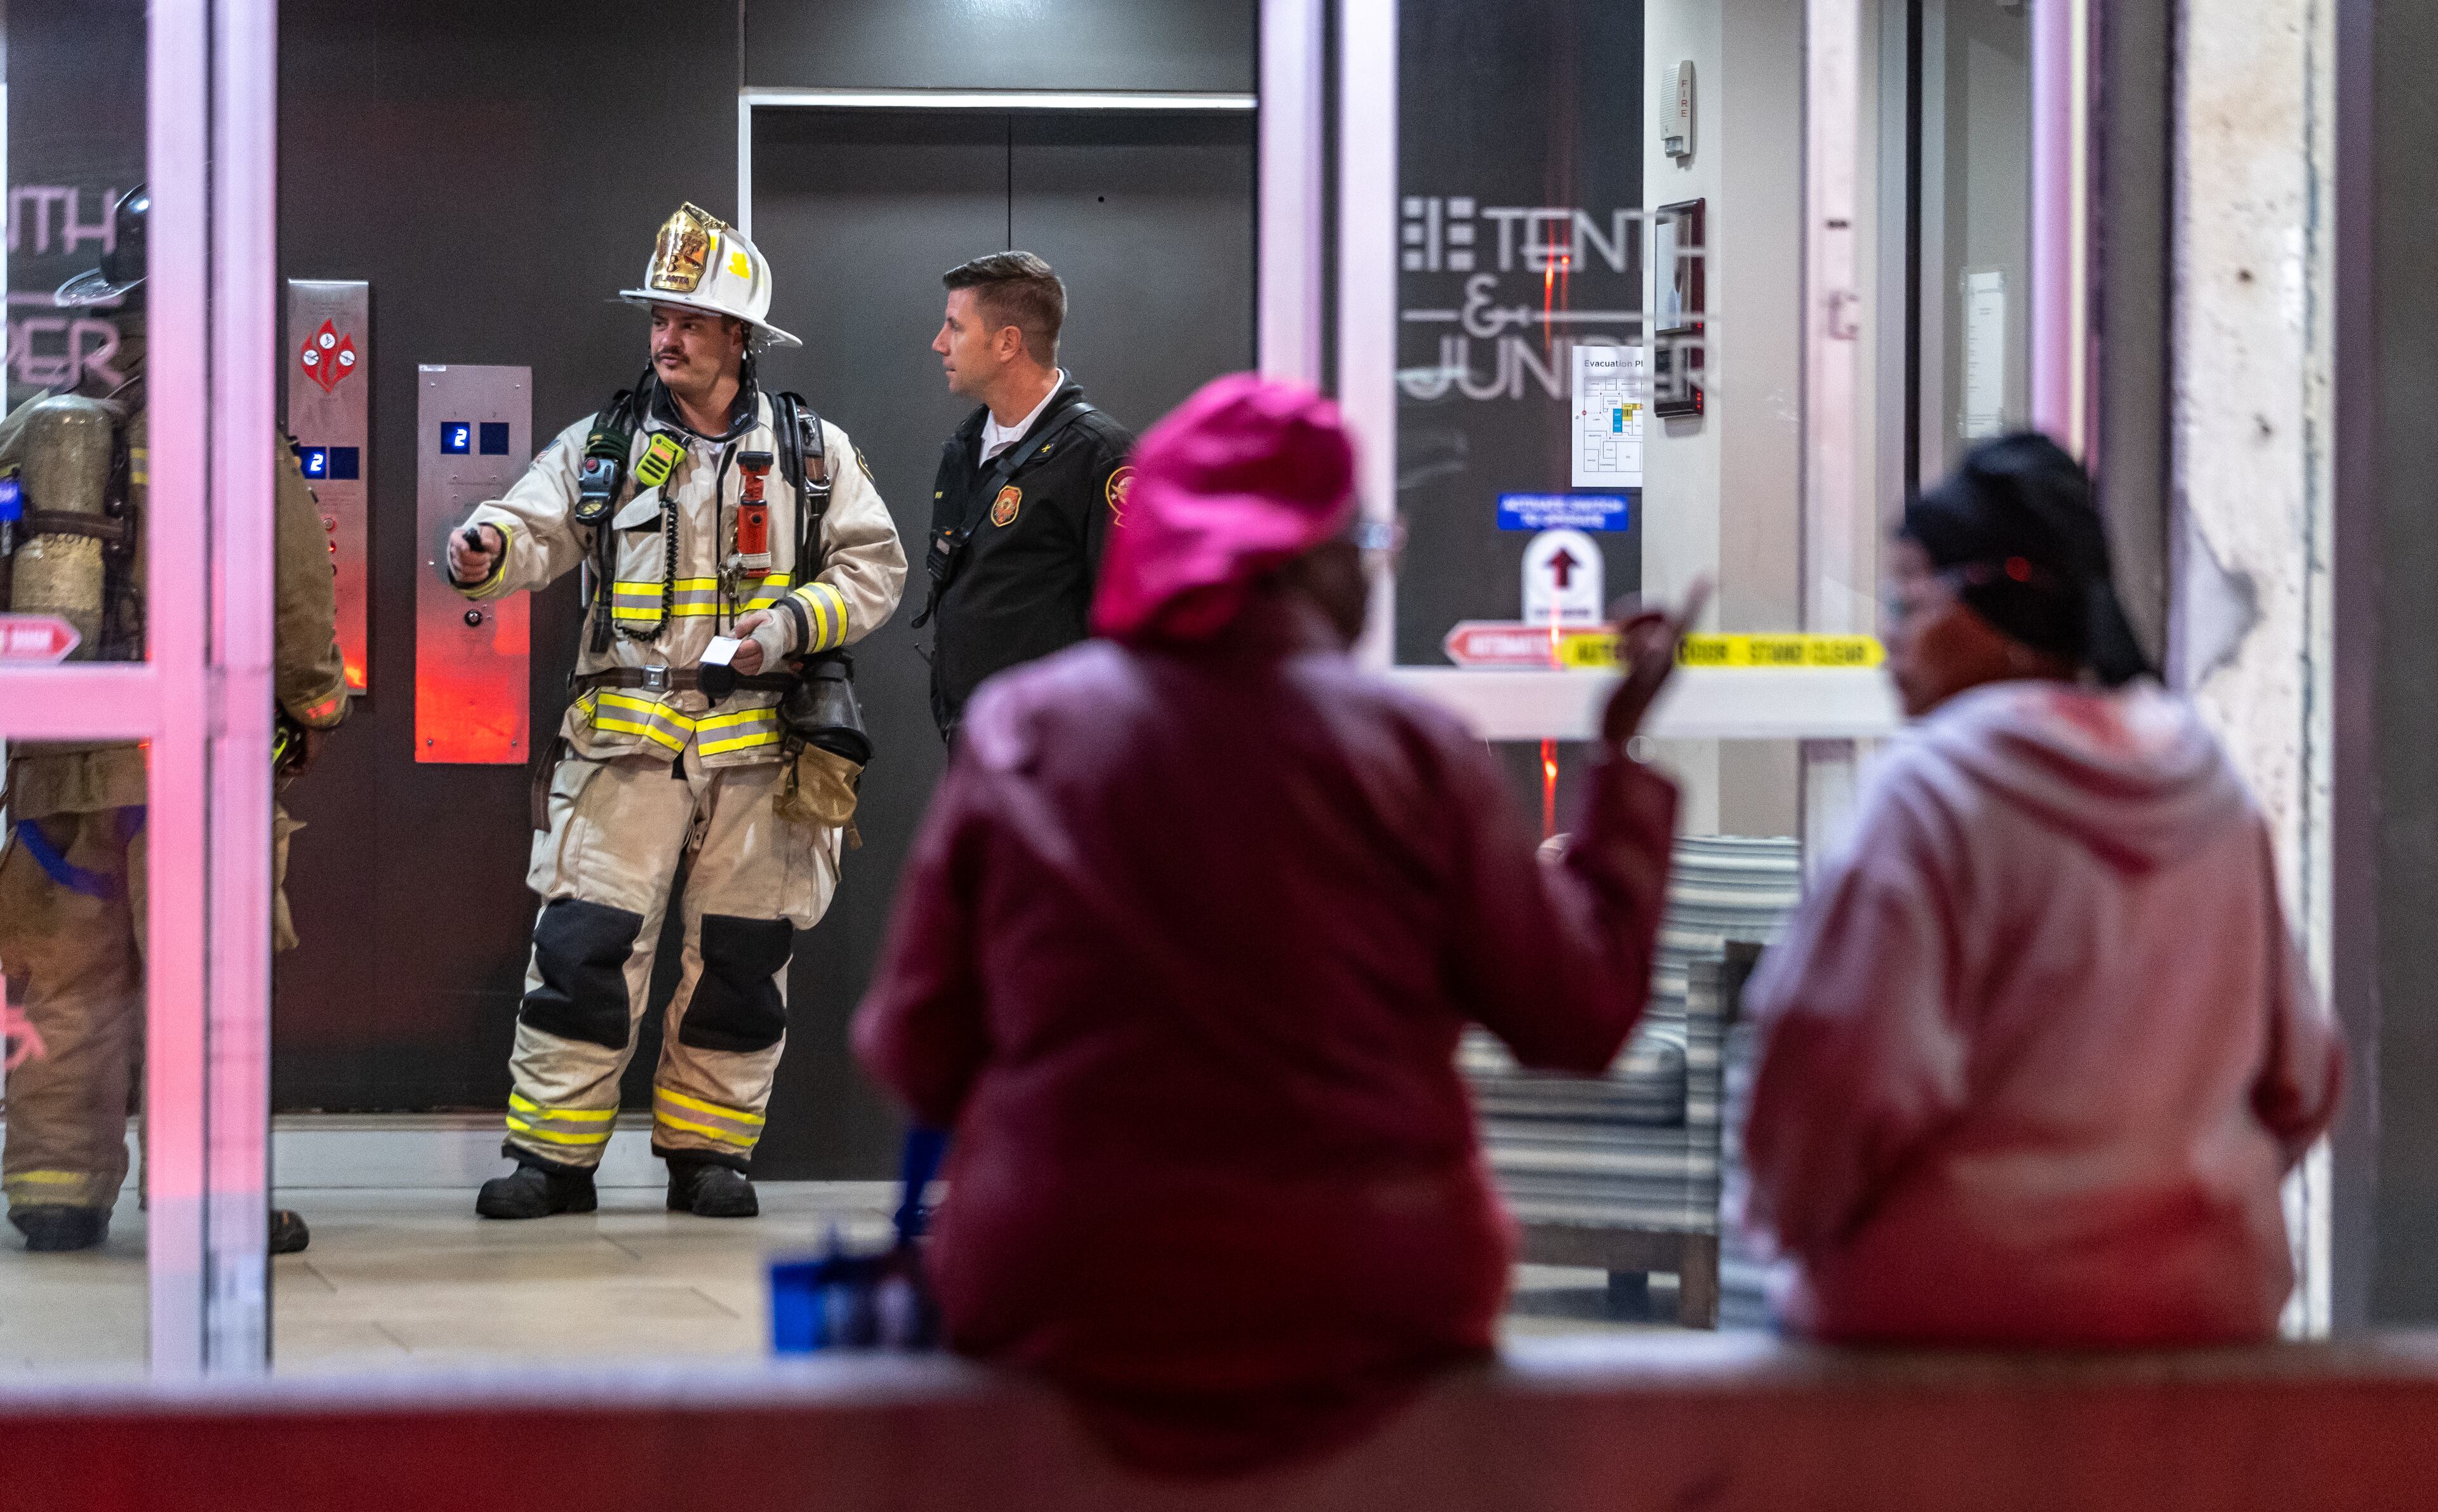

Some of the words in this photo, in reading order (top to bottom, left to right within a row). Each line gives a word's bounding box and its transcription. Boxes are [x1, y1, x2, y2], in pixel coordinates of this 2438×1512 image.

[1584, 359, 1632, 368] Evacuation
[454, 428, 467, 447] 2
[310, 453, 324, 472] 2
